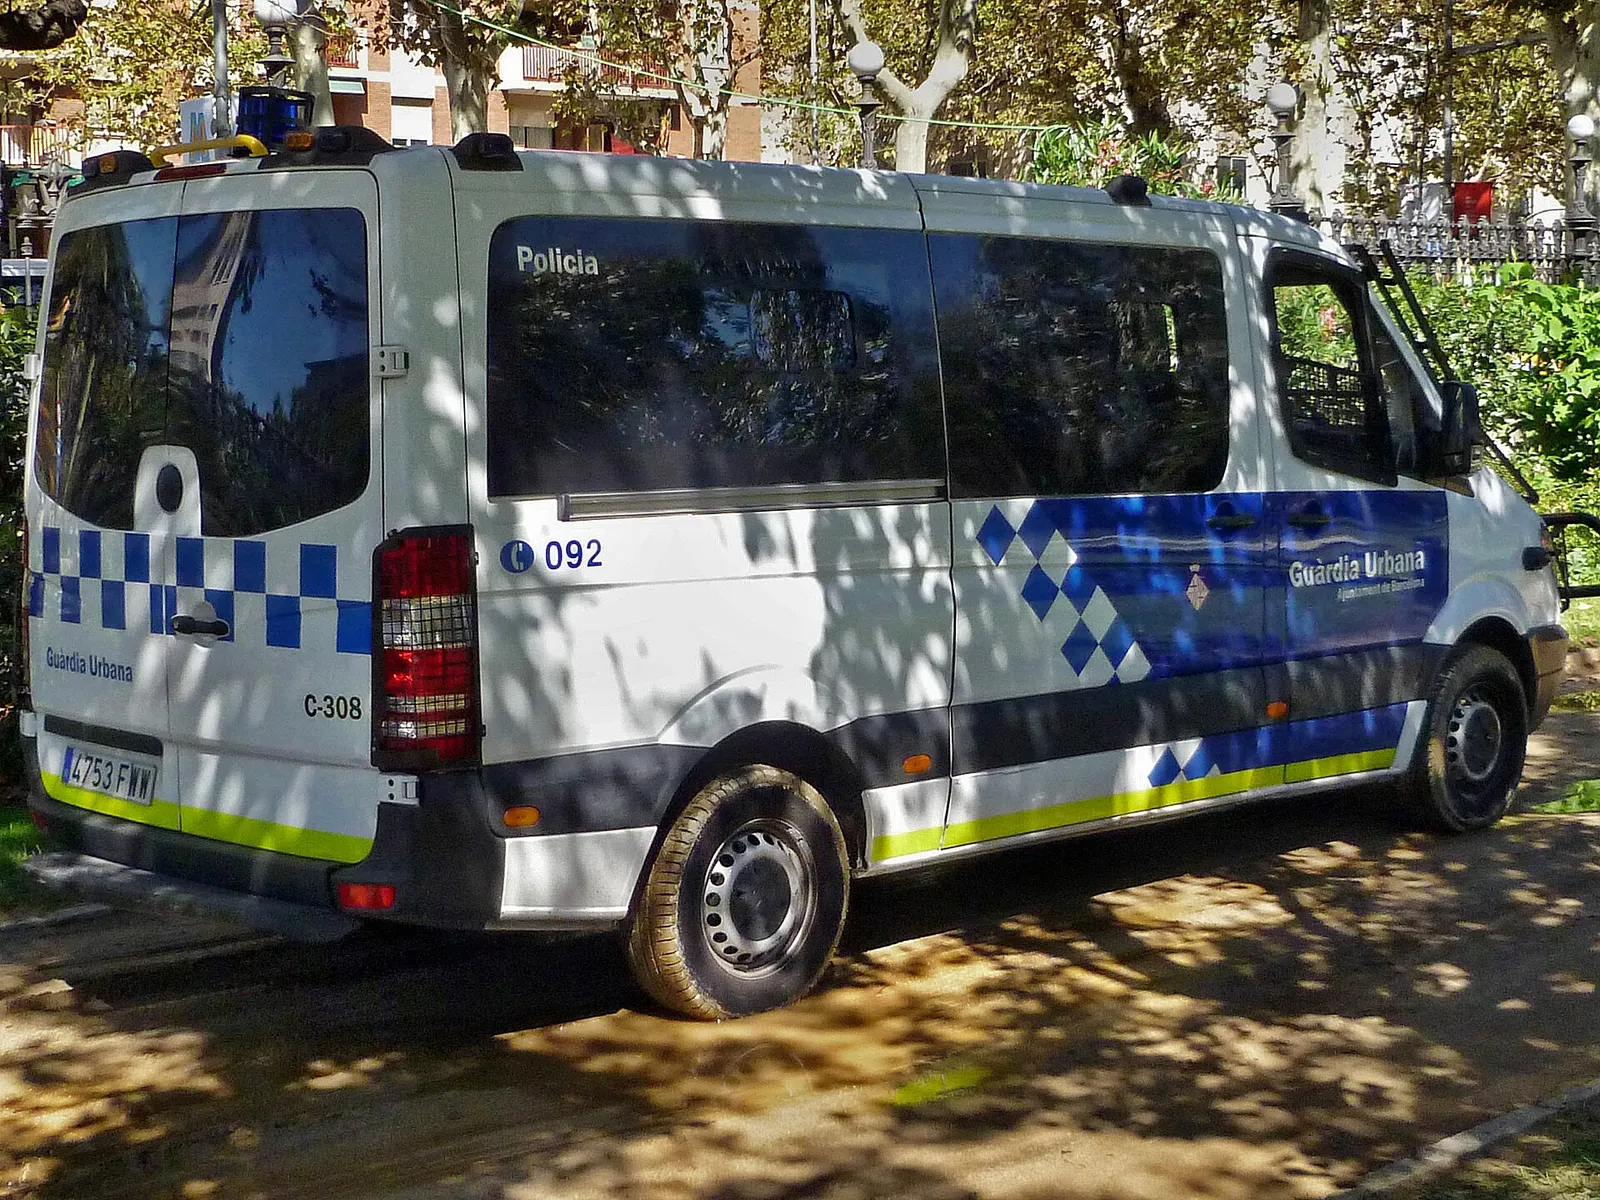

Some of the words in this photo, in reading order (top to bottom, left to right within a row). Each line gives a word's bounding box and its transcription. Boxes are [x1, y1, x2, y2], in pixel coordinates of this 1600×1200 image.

[516, 245, 599, 276] Policia
[545, 539, 603, 570] 092
[1289, 555, 1360, 588] Guàrdia
[1364, 550, 1425, 578] Urbana
[89, 655, 133, 682] Urbana
[304, 693, 363, 720] C-308
[72, 753, 114, 790] 4753
